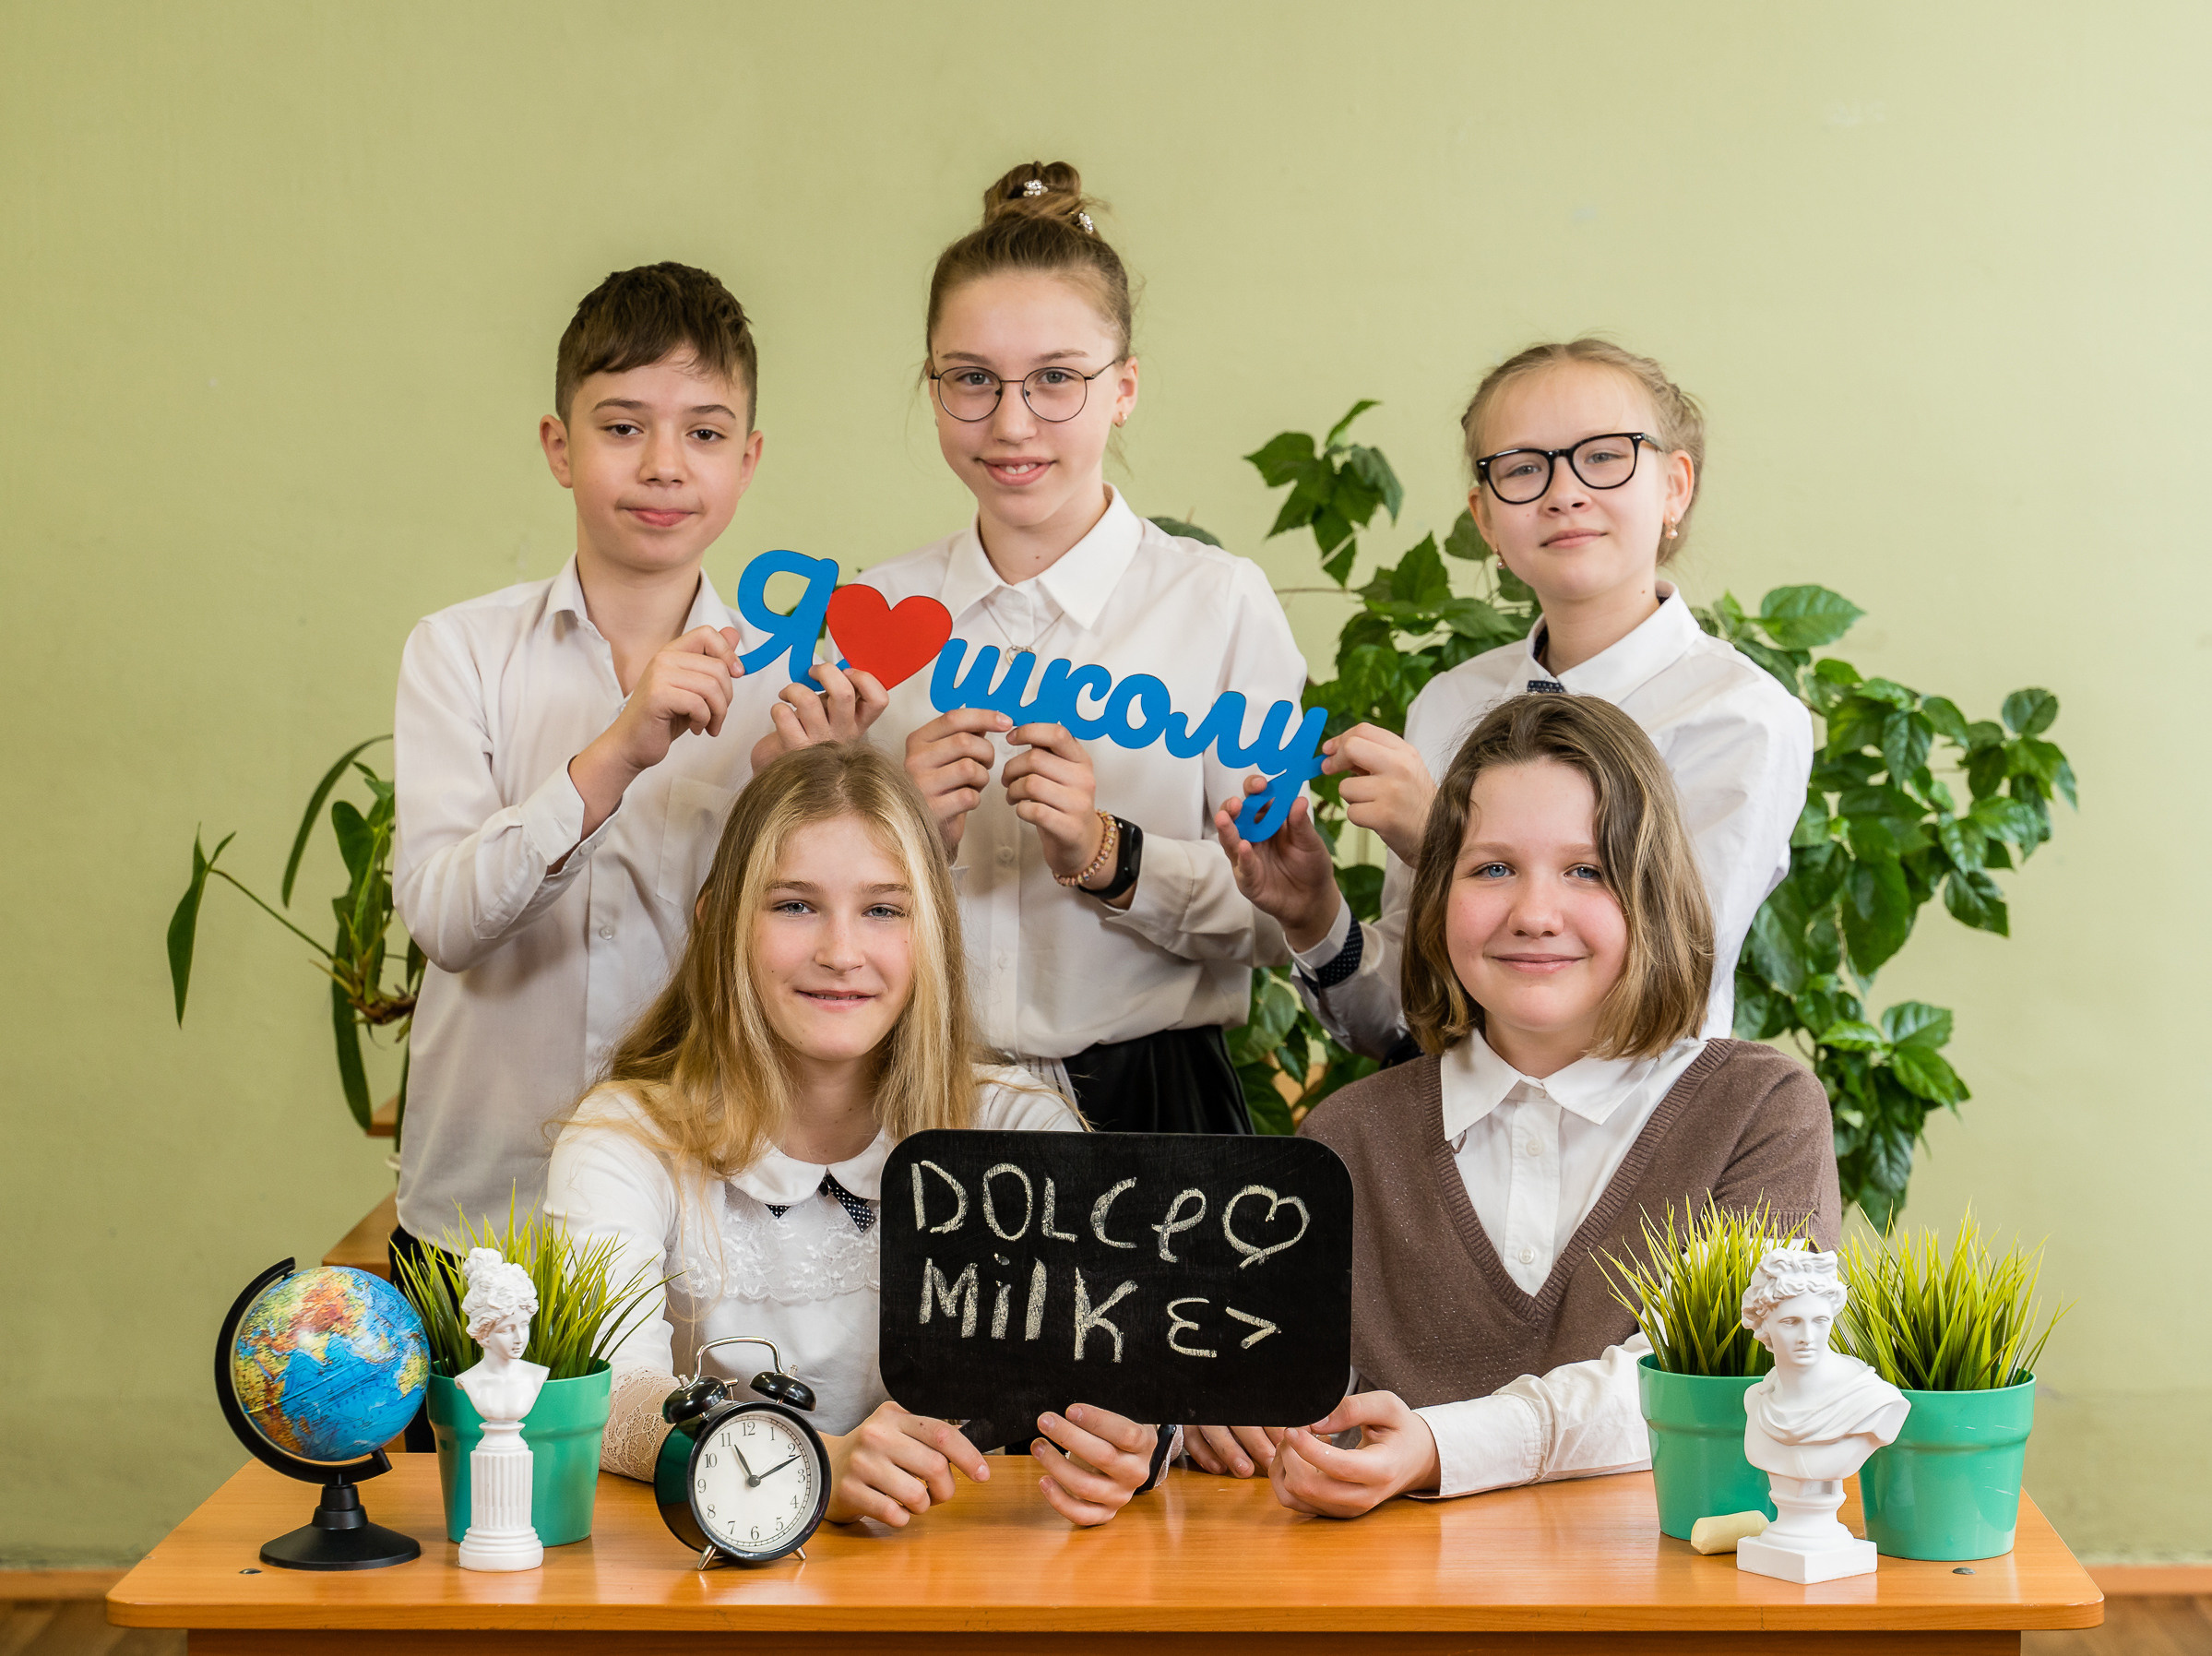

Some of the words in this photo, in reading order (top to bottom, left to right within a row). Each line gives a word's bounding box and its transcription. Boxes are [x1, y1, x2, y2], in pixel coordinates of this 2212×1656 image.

[738, 549, 850, 693] Я
[930, 638, 1328, 843] школу
[742, 1421, 756, 1436] 12
[769, 1426, 776, 1441] 1
[720, 1432, 732, 1448] 11
[788, 1442, 797, 1458] 2
[704, 1452, 718, 1469] 10
[797, 1469, 806, 1483] 3
[697, 1478, 707, 1494] 9
[790, 1495, 800, 1509] 4
[707, 1504, 716, 1519] 8
[727, 1520, 736, 1535] 7
[775, 1517, 784, 1531] 5
[750, 1525, 760, 1541] 6
